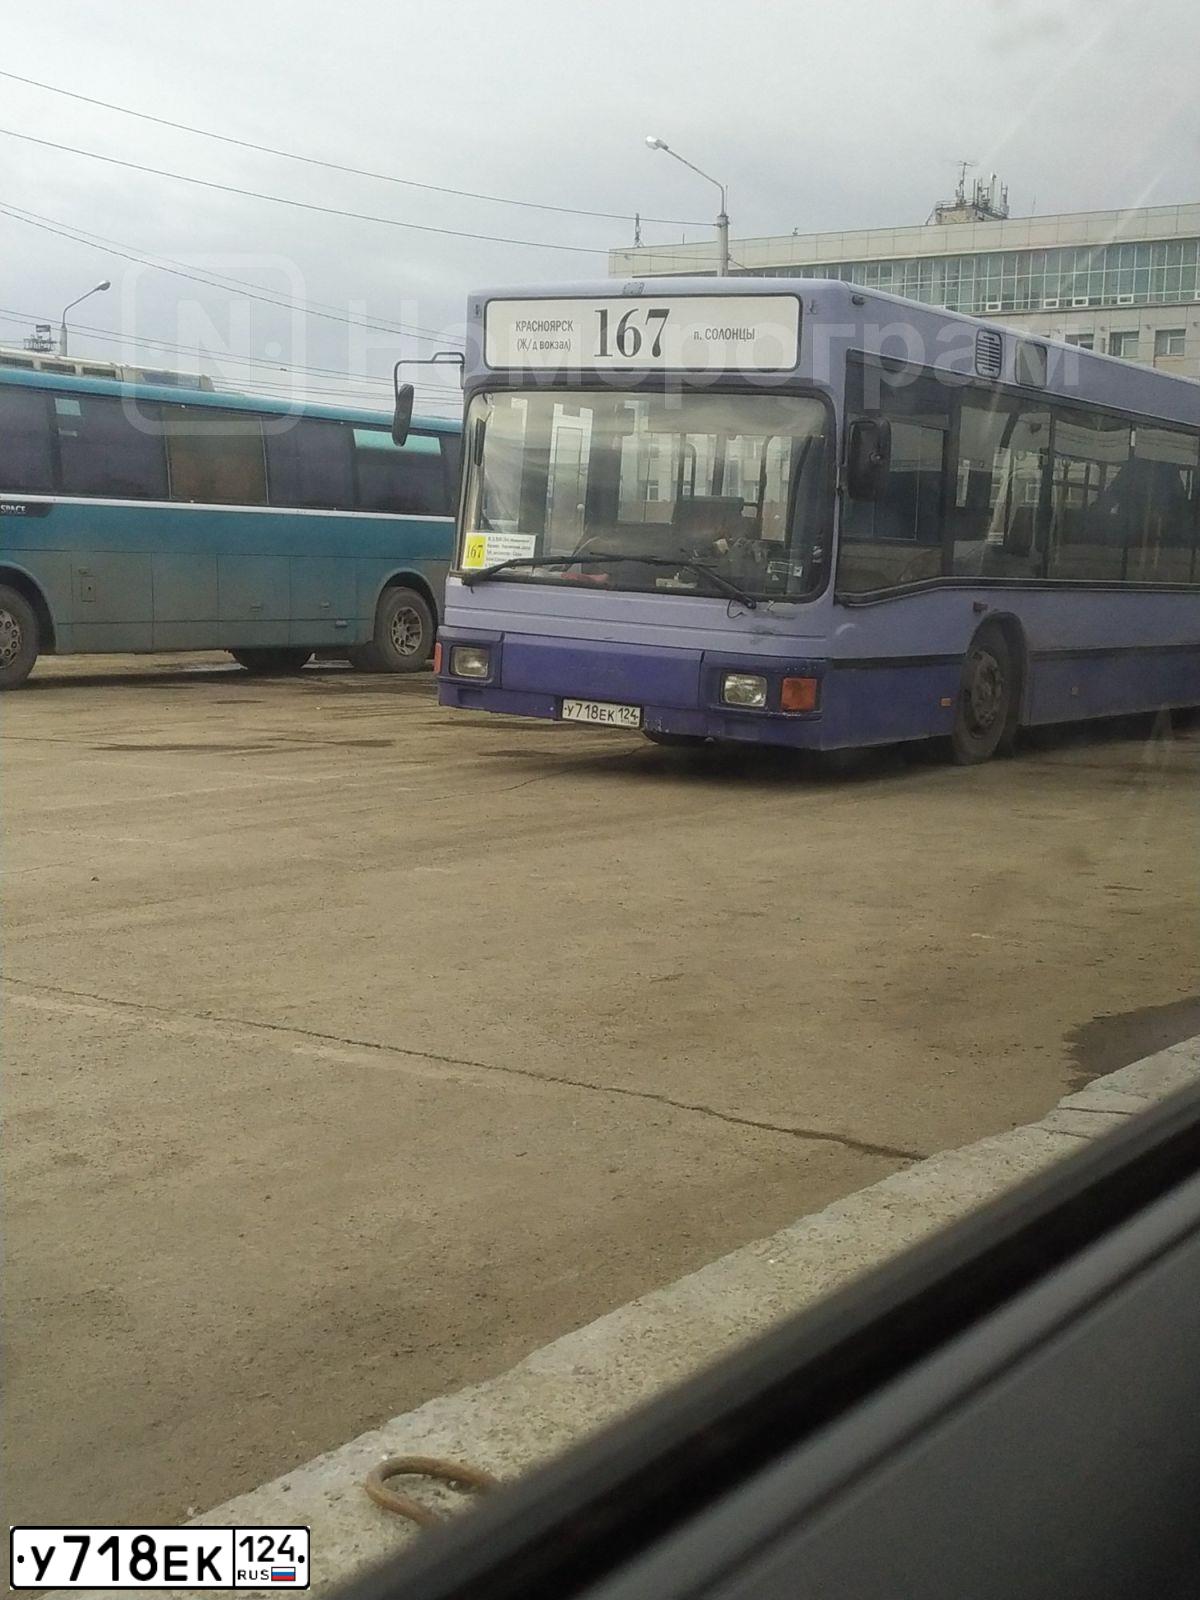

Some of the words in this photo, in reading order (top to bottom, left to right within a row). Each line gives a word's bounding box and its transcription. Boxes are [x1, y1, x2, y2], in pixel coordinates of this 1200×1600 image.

[515, 319, 574, 332] КРАСНОЯРСК
[594, 308, 670, 357] 167
[693, 331, 702, 340] п.
[705, 328, 755, 342] СОЛОНЦЫ
[539, 339, 571, 351] вокзал)
[467, 544, 483, 558] 167
[567, 702, 615, 722] У718ЕК
[618, 707, 637, 720] 124
